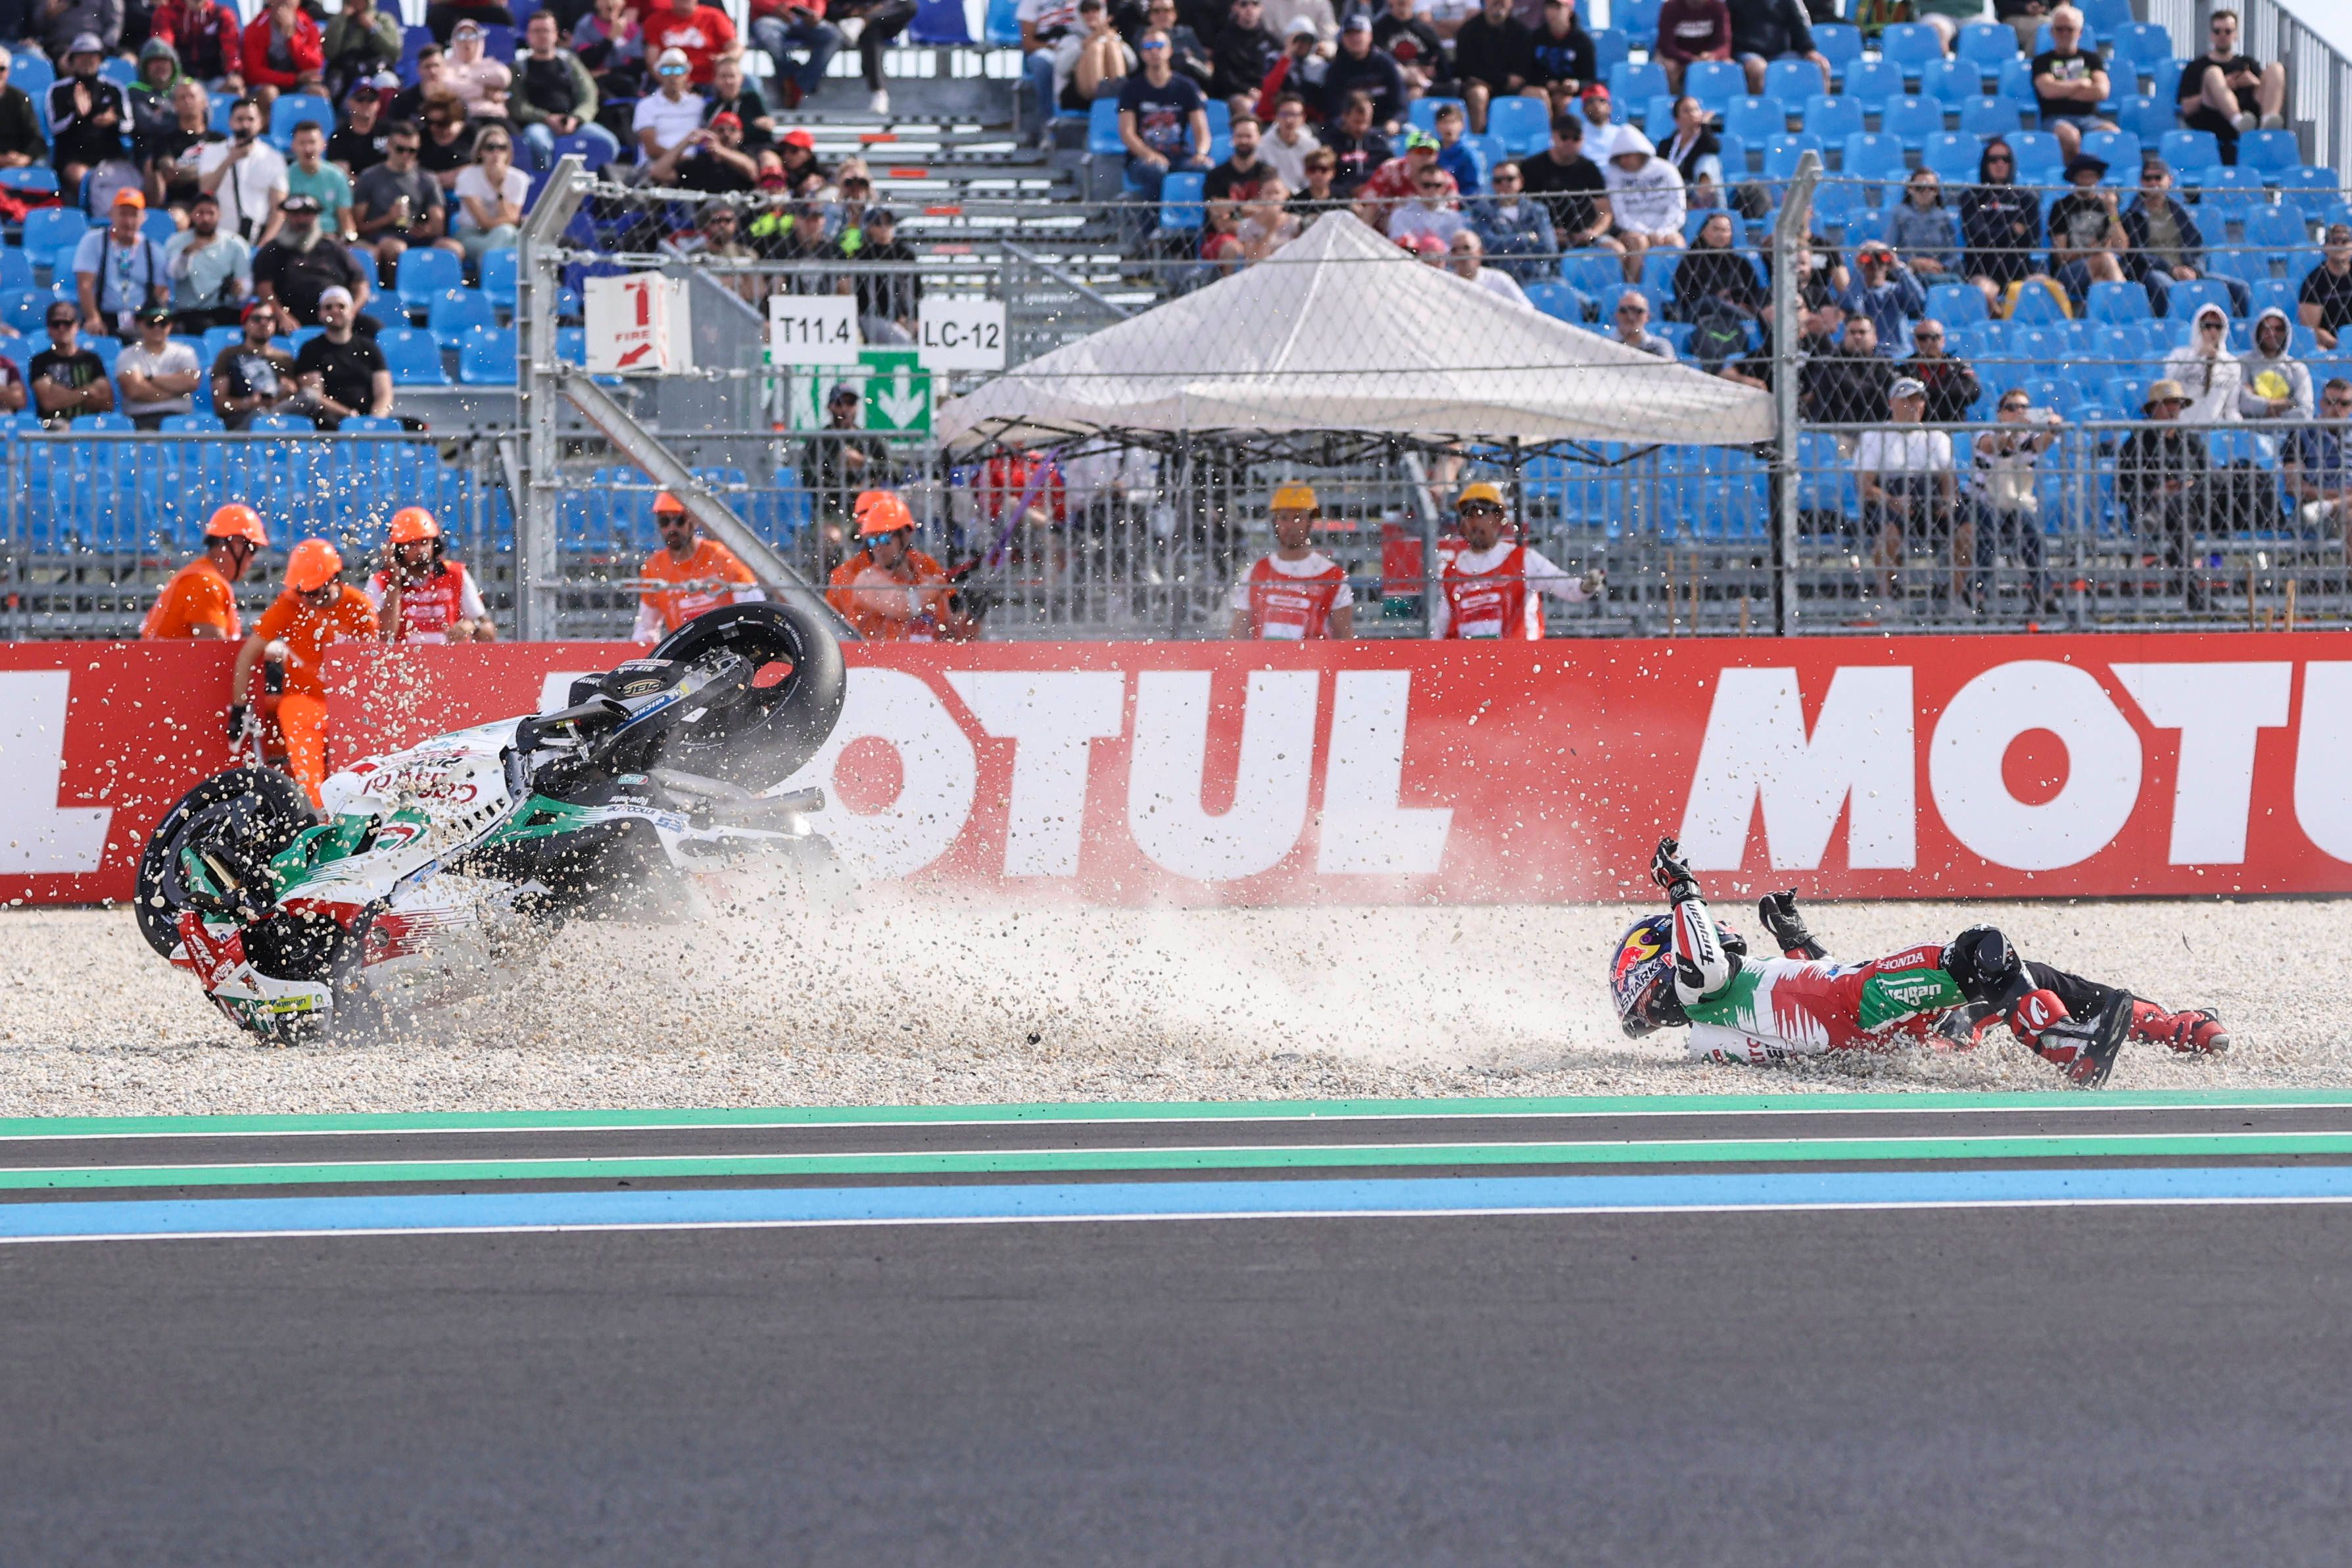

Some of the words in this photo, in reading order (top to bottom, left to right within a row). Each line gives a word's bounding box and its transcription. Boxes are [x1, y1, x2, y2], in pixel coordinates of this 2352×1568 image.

[614, 330, 651, 343] FIRE
[779, 317, 850, 344] T11.4
[924, 321, 999, 348] LC-12
[537, 666, 1454, 880] OTUL
[1621, 961, 1659, 1010] SHARK
